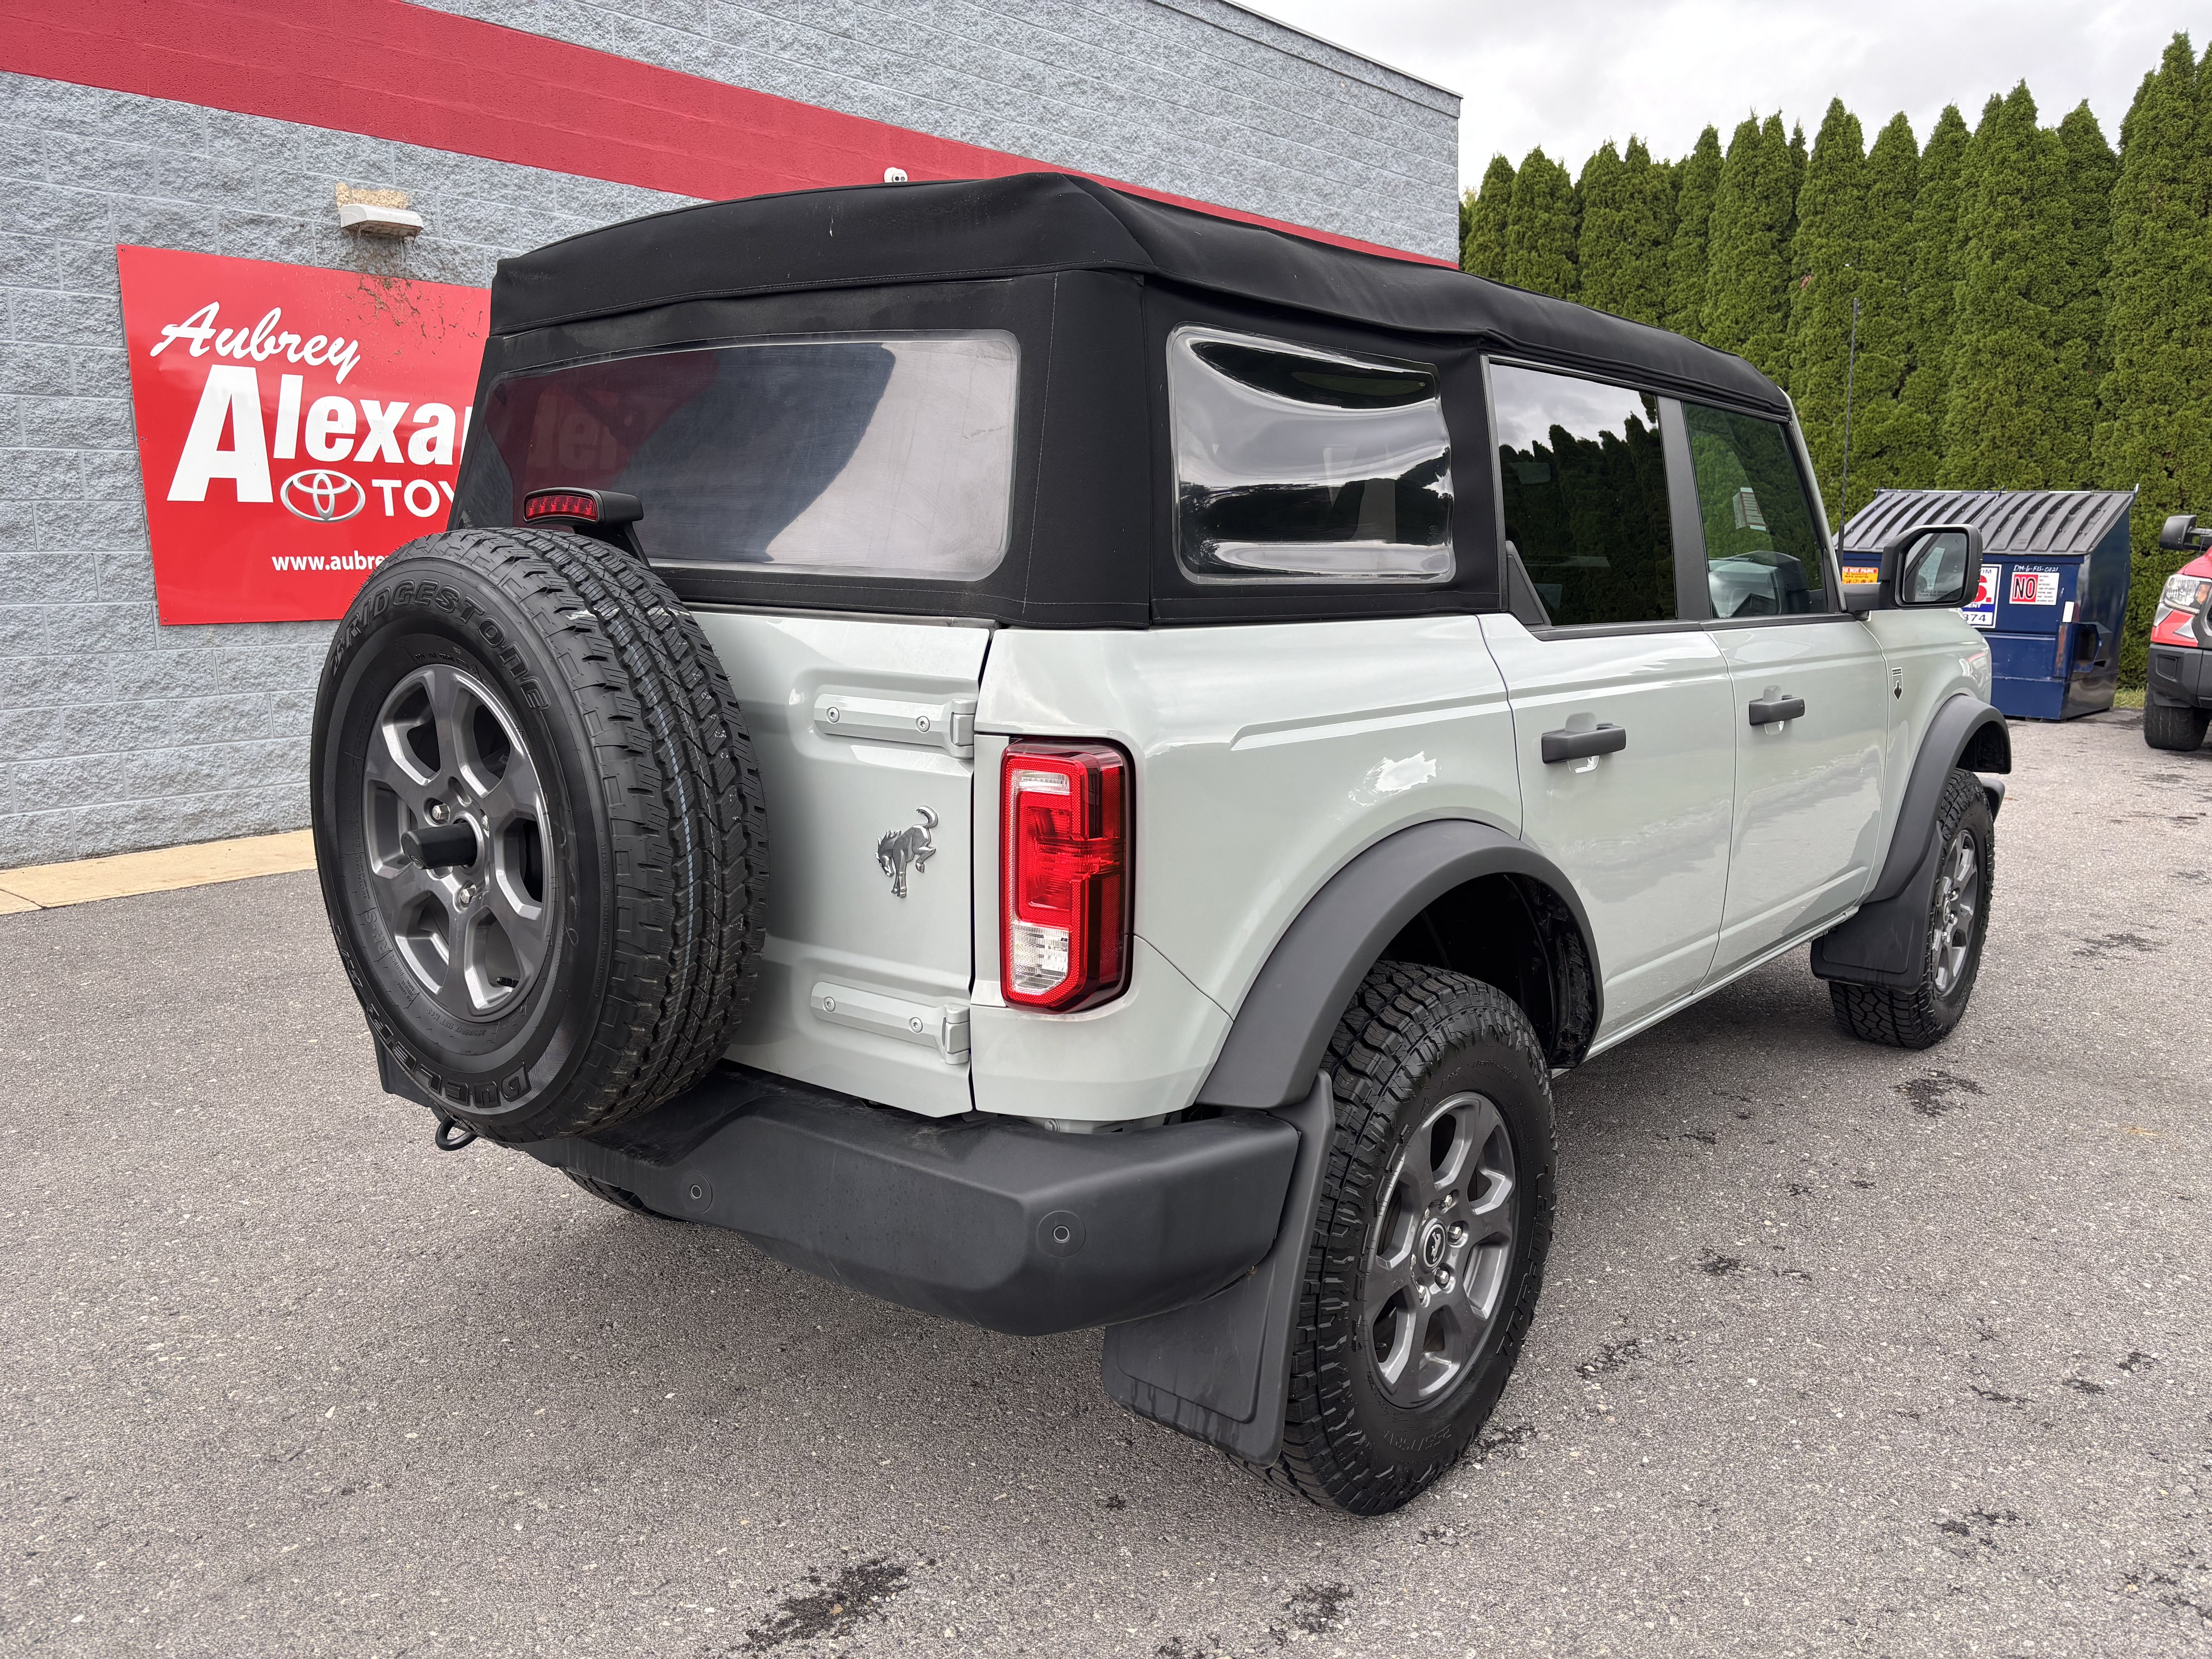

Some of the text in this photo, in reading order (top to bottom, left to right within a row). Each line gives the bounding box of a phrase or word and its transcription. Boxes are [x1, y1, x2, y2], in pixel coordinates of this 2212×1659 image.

[150, 301, 361, 385] Aubrey
[167, 364, 472, 503] Alexa
[271, 550, 390, 570] www.aubre
[2013, 577, 2036, 600] NO
[332, 579, 551, 710] BRIDGESTONE
[366, 1002, 532, 1109] DUELER
